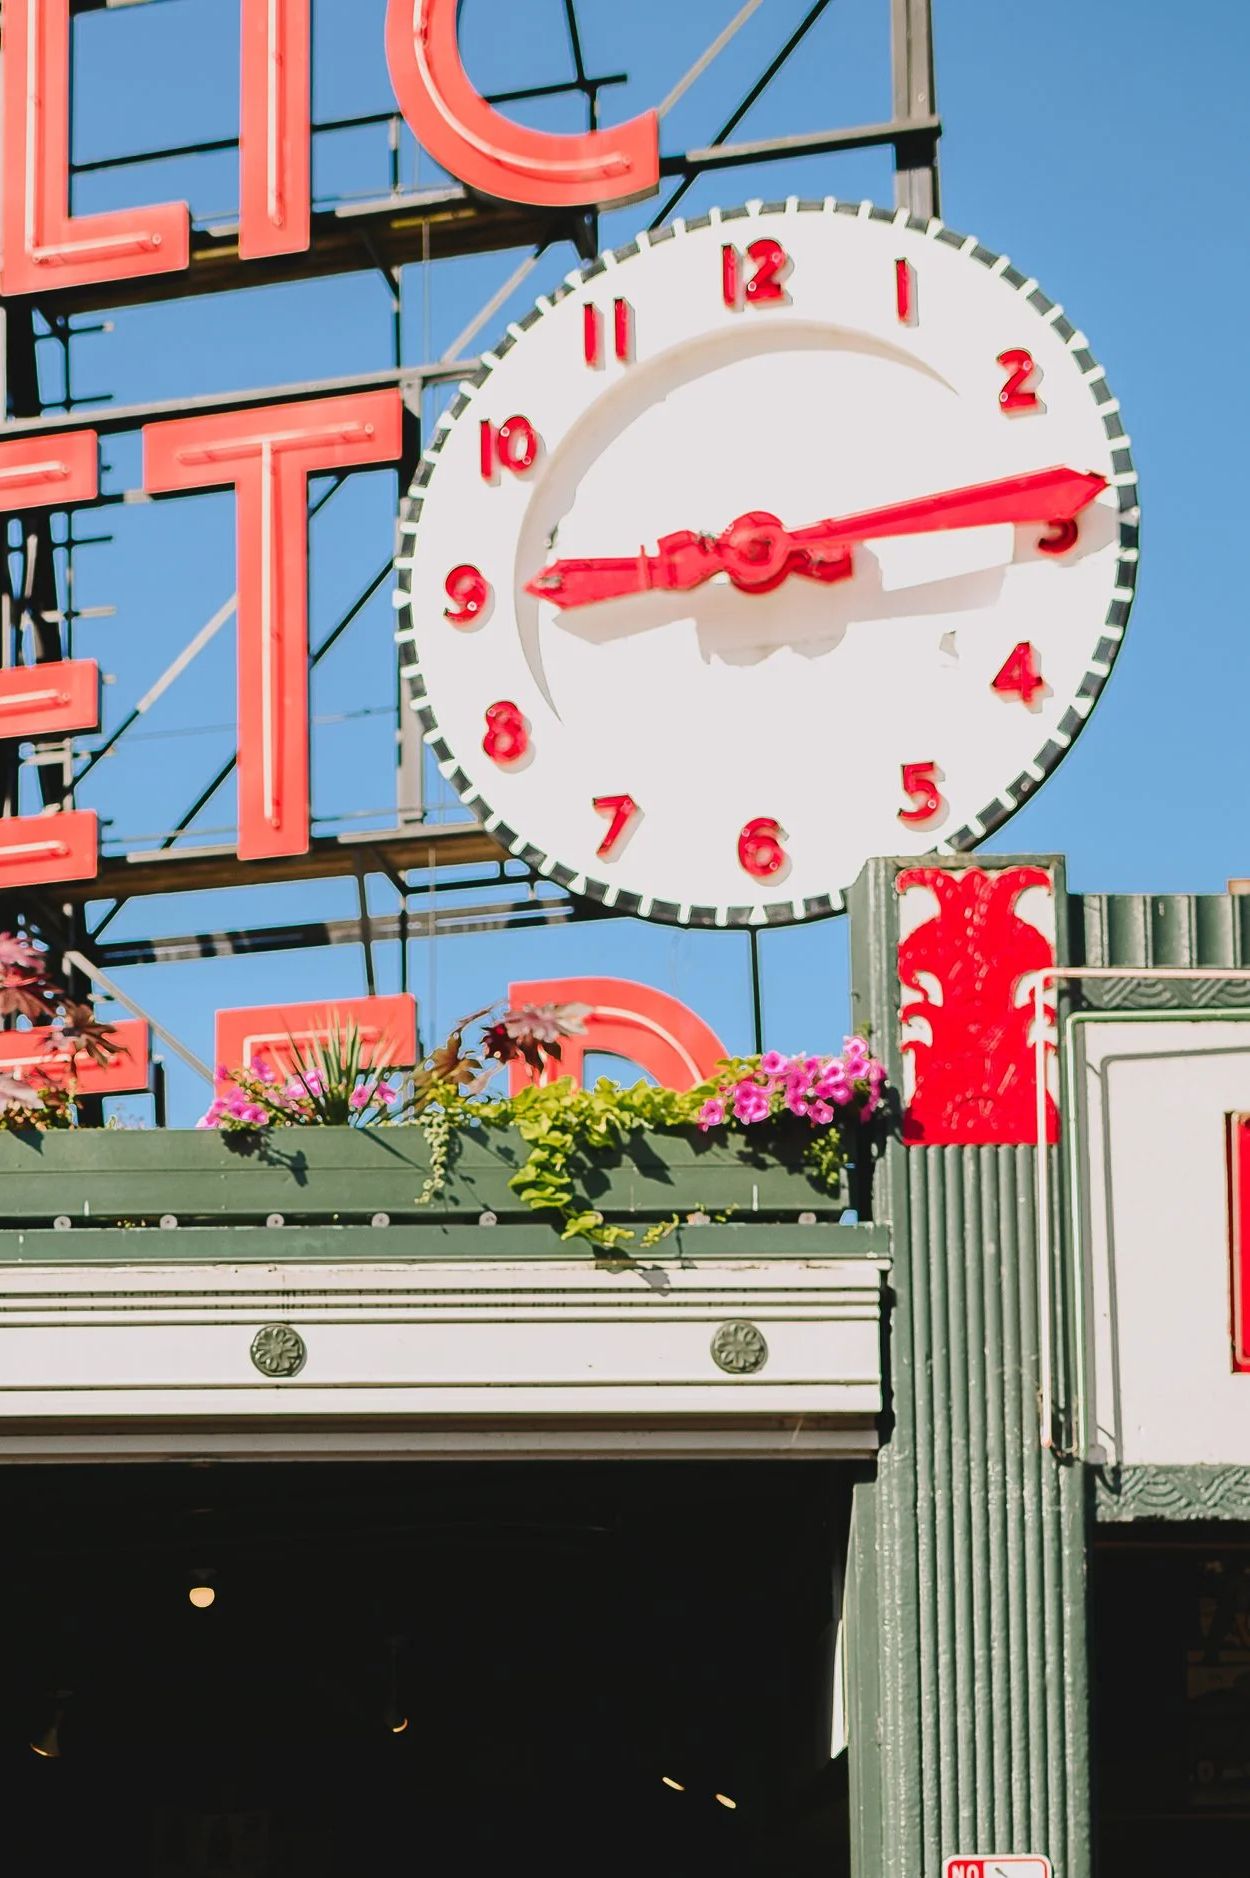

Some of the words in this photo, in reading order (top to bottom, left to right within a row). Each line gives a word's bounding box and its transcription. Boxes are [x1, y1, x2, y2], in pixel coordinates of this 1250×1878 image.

[720, 238, 788, 306] 12
[894, 257, 912, 323] 1
[584, 297, 630, 366] 11
[997, 348, 1038, 411] 2
[480, 415, 538, 477] 10
[444, 563, 488, 624] 9
[991, 641, 1044, 703] 4
[483, 700, 530, 763] 8
[899, 761, 943, 821] 5
[593, 794, 634, 857] 7
[737, 817, 787, 877] 6
